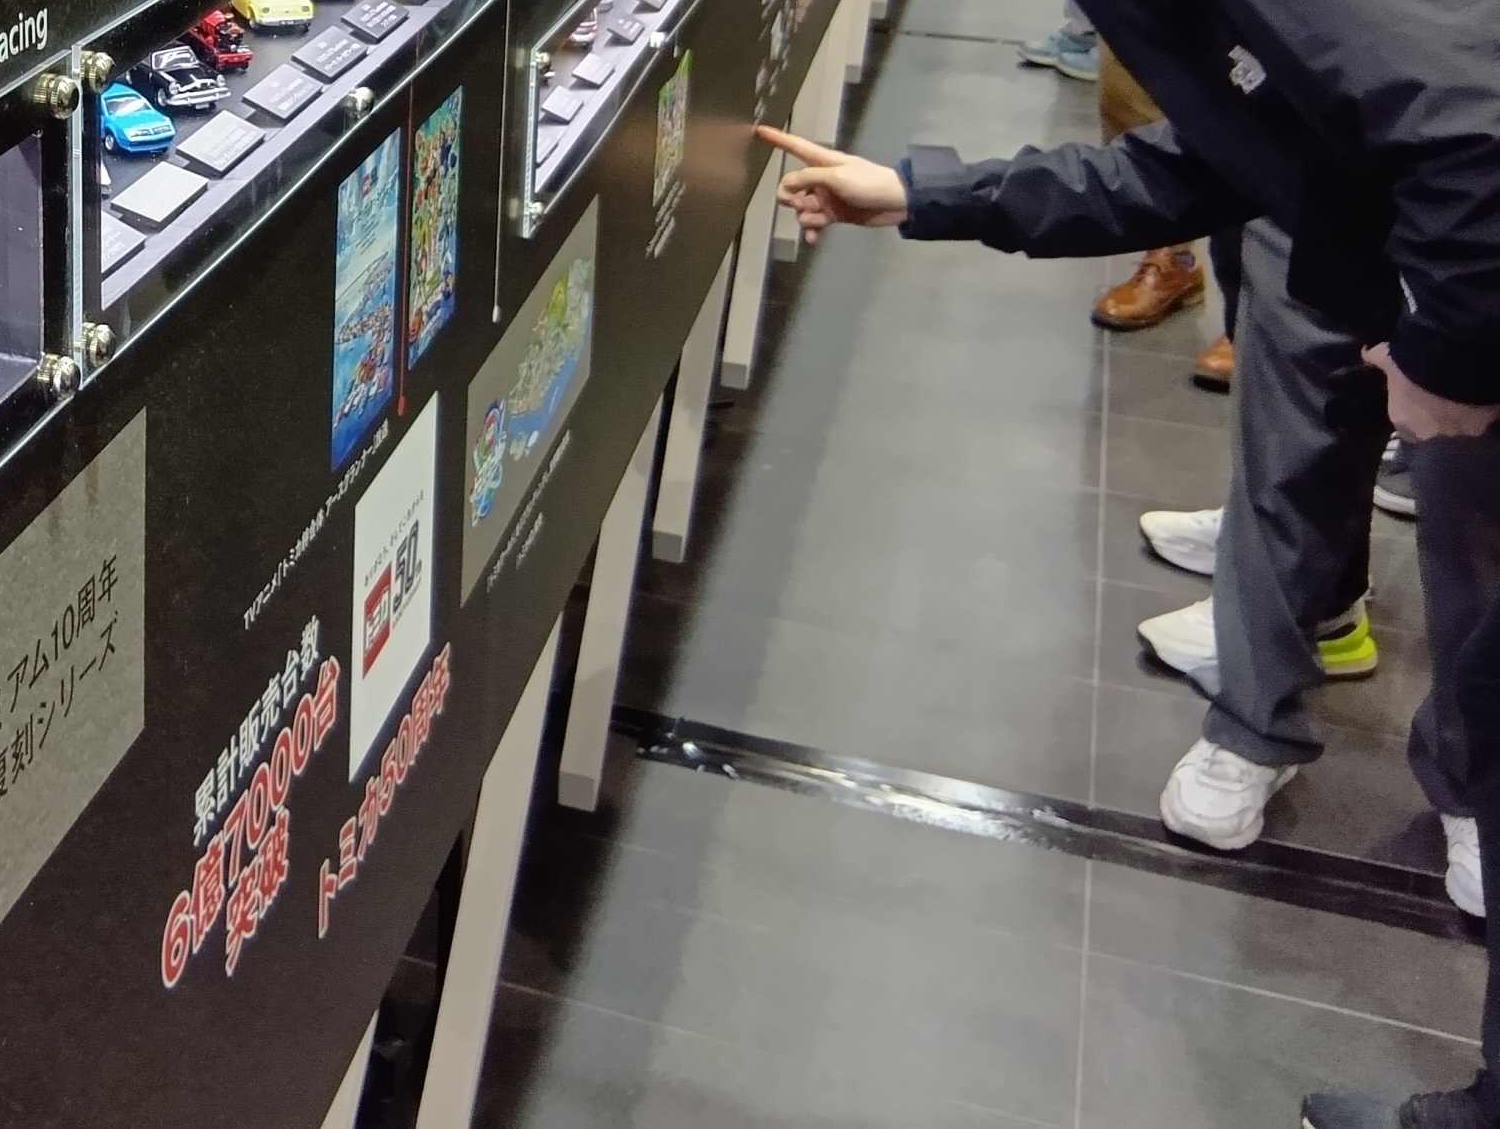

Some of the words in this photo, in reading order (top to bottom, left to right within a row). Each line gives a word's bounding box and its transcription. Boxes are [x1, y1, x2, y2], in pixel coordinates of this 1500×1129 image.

[193, 613, 321, 847] 累計販売台数
[318, 641, 451, 940] トミカ50周年
[224, 805, 290, 977] 突破
